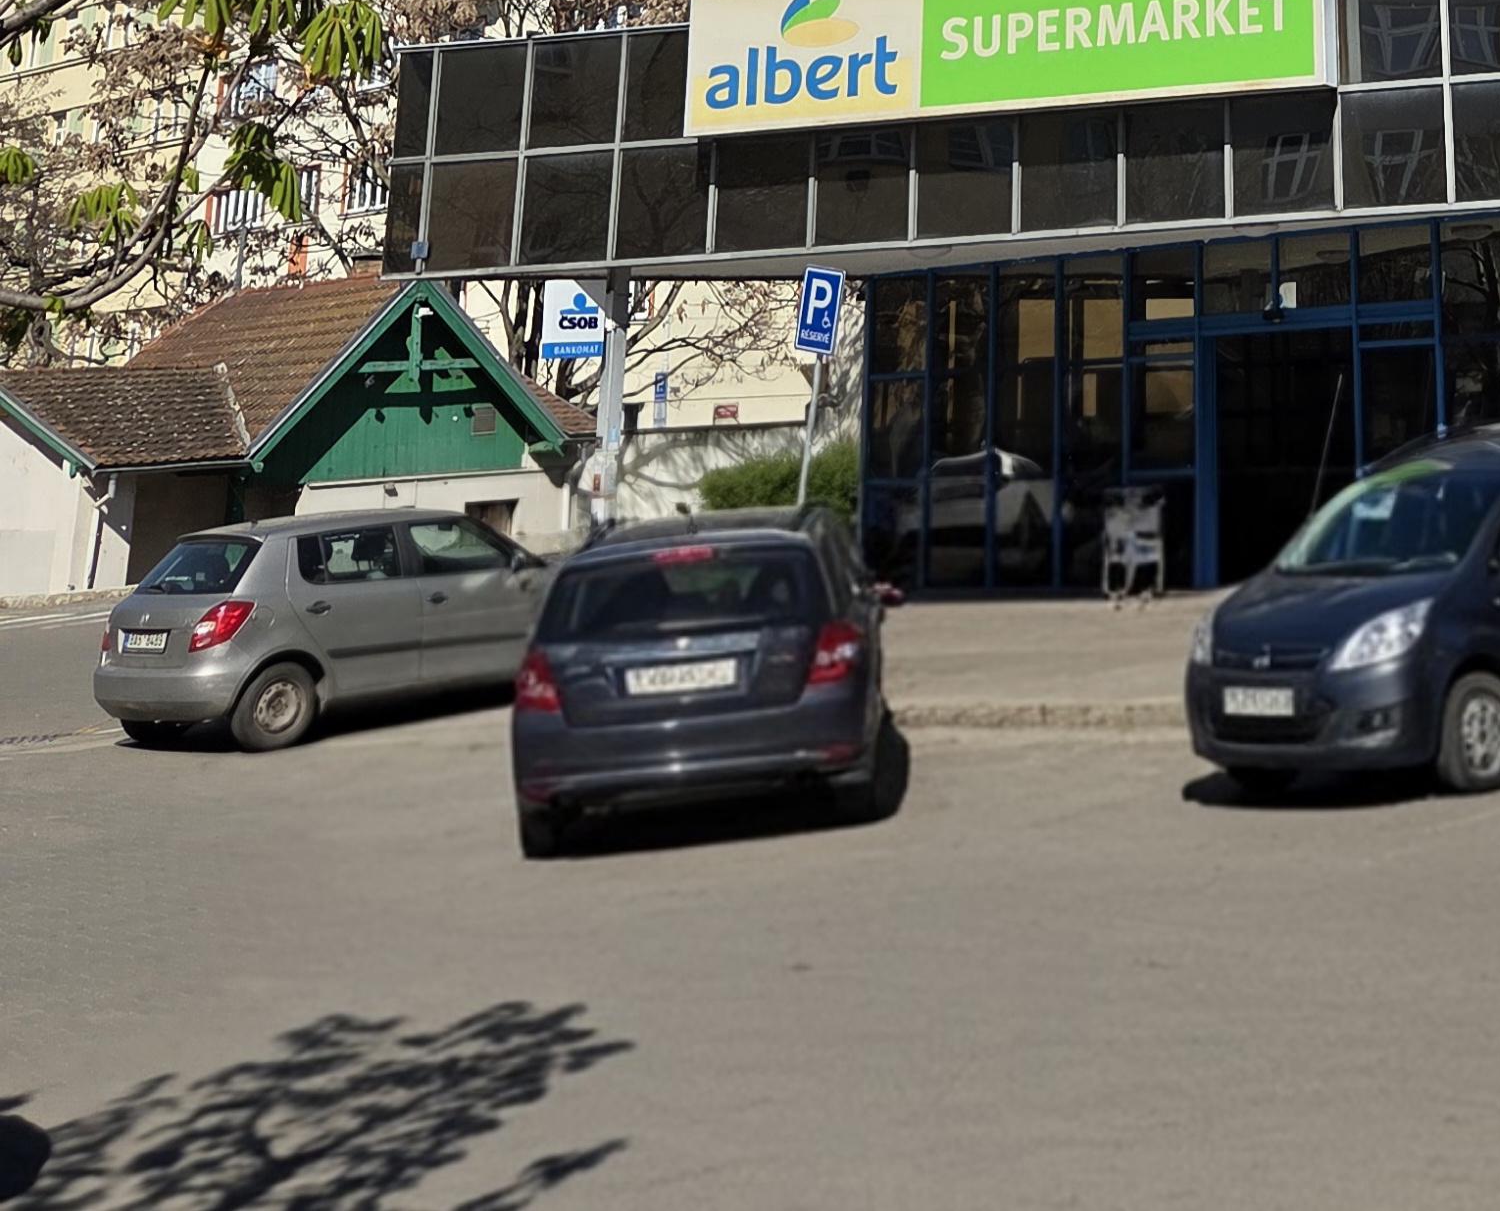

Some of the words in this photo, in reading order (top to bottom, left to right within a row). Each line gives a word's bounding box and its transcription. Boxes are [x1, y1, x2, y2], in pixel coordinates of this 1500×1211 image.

[705, 35, 898, 110] albert
[806, 277, 833, 325] P
[558, 314, 599, 330] ČSOB
[553, 345, 600, 356] BANKOMAT
